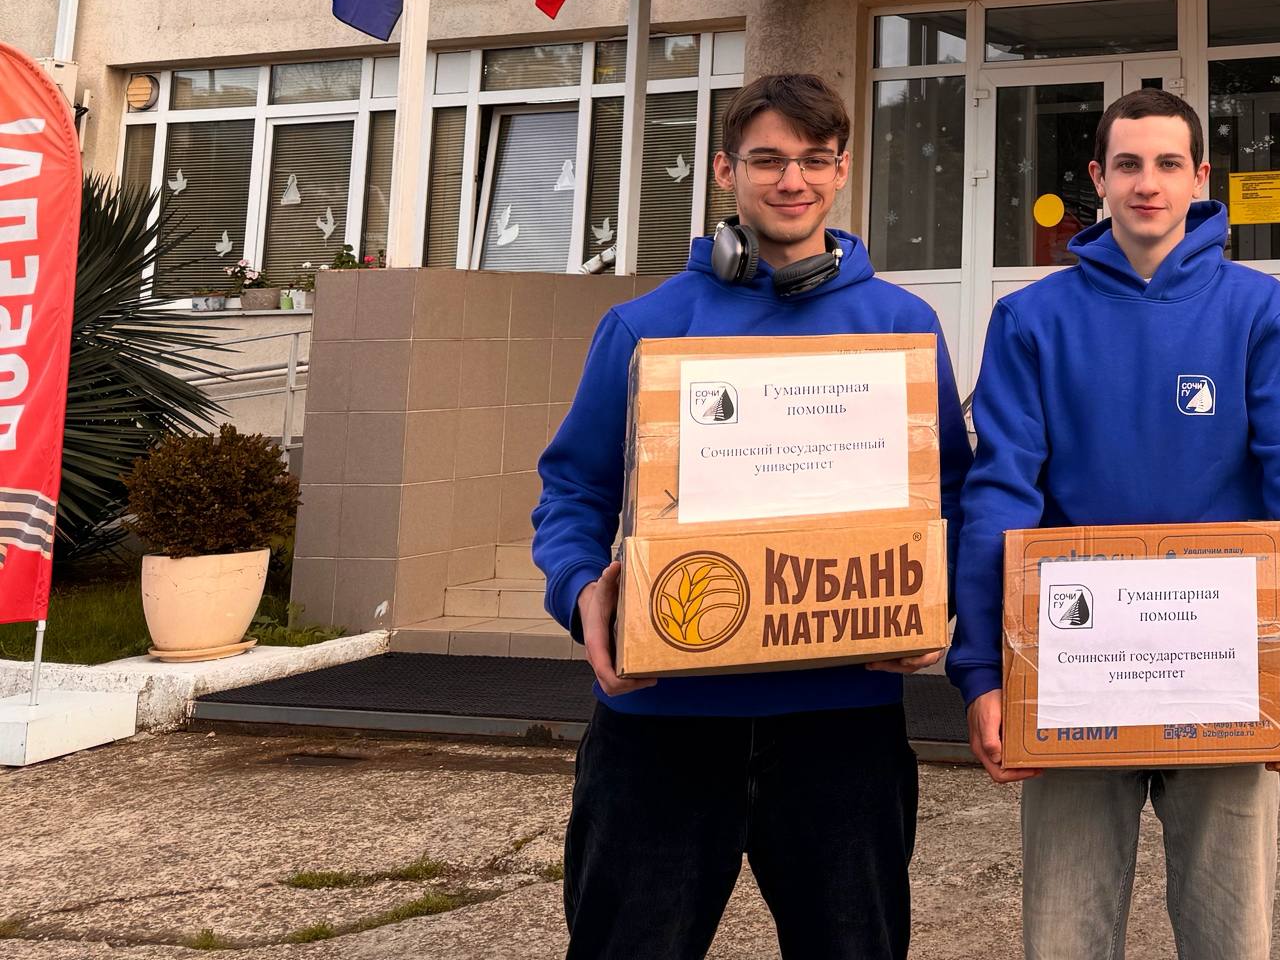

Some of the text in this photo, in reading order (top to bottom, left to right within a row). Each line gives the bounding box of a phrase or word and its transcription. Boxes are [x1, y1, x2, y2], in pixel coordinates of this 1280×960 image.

[763, 383, 869, 399] Гуманитарная
[1181, 382, 1203, 390] СОЧИ
[1181, 389, 1191, 397] ГУ
[695, 390, 720, 398] СОЧИ
[695, 398, 707, 406] ГУ
[787, 404, 847, 416] помощь
[700, 438, 886, 459] Сочинский государственный
[754, 460, 835, 476] университет
[764, 543, 924, 606] КУБАНЬ
[1053, 592, 1077, 601] СОЧИ
[1118, 588, 1220, 604] Гуманитарная
[1053, 601, 1065, 609] ГУ
[1140, 611, 1198, 622] помощь
[761, 603, 924, 648] МАТУШКА
[1057, 647, 1236, 664] Сочинский государственный
[1108, 669, 1185, 683] университет
[1057, 725, 1118, 742] нами
